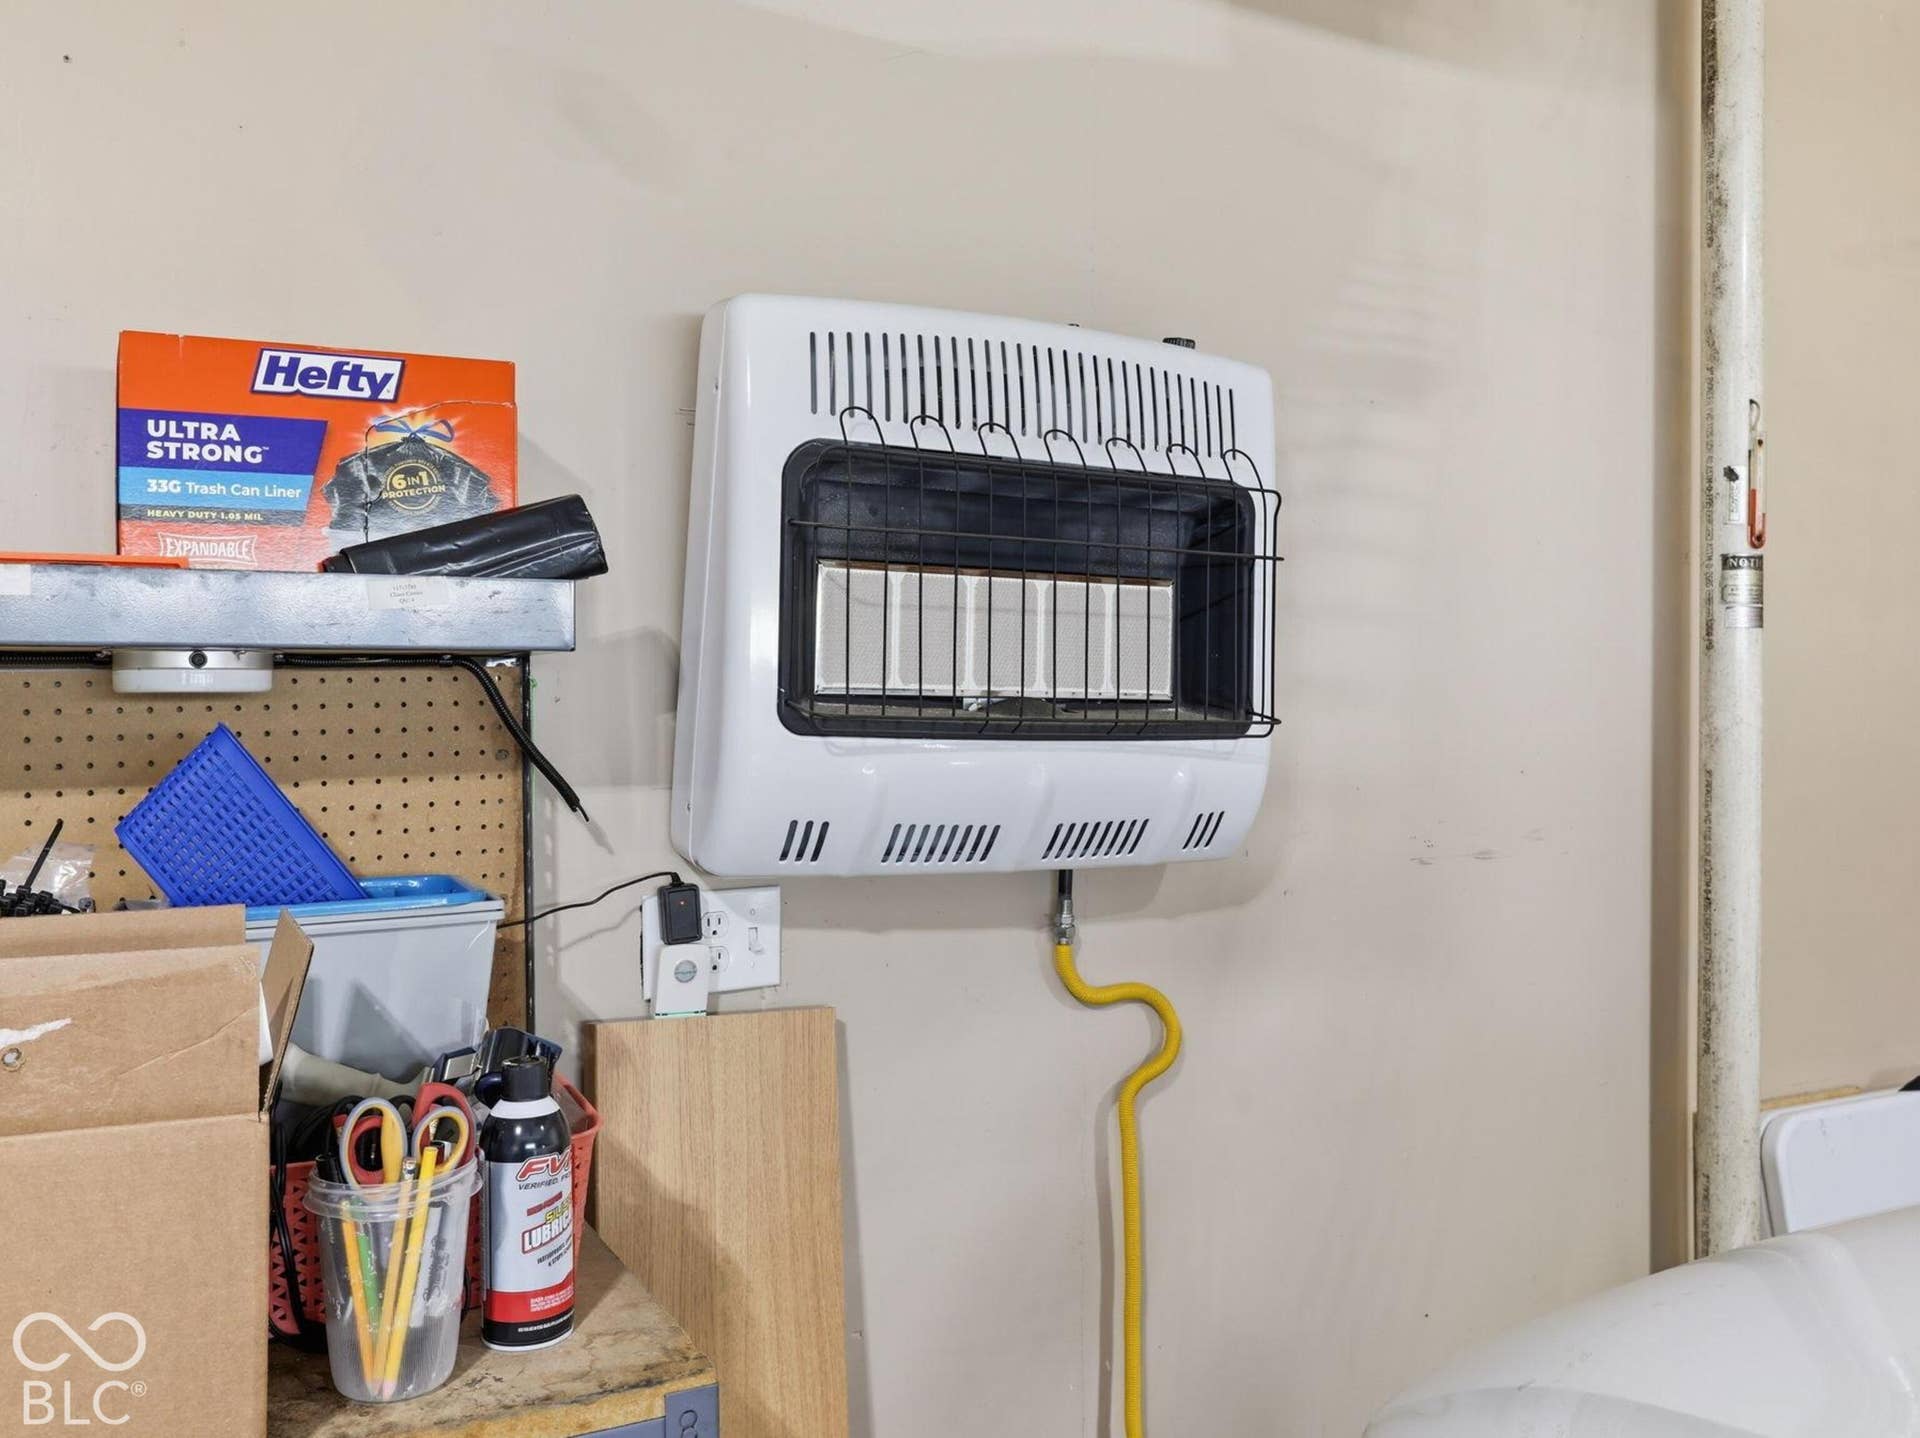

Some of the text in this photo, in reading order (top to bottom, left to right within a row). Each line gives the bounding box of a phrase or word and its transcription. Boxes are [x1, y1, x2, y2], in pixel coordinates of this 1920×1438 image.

[262, 354, 395, 400] Hefty
[147, 419, 241, 441] ULTRA
[147, 478, 303, 498] 33G Trash Can Liner
[382, 484, 446, 500] PROTECTION
[147, 509, 186, 518] HEAVY
[188, 511, 218, 519] DUTY
[244, 512, 264, 521] MIL
[166, 537, 251, 560] EXPANDABLE
[1728, 557, 1760, 568] NOTI
